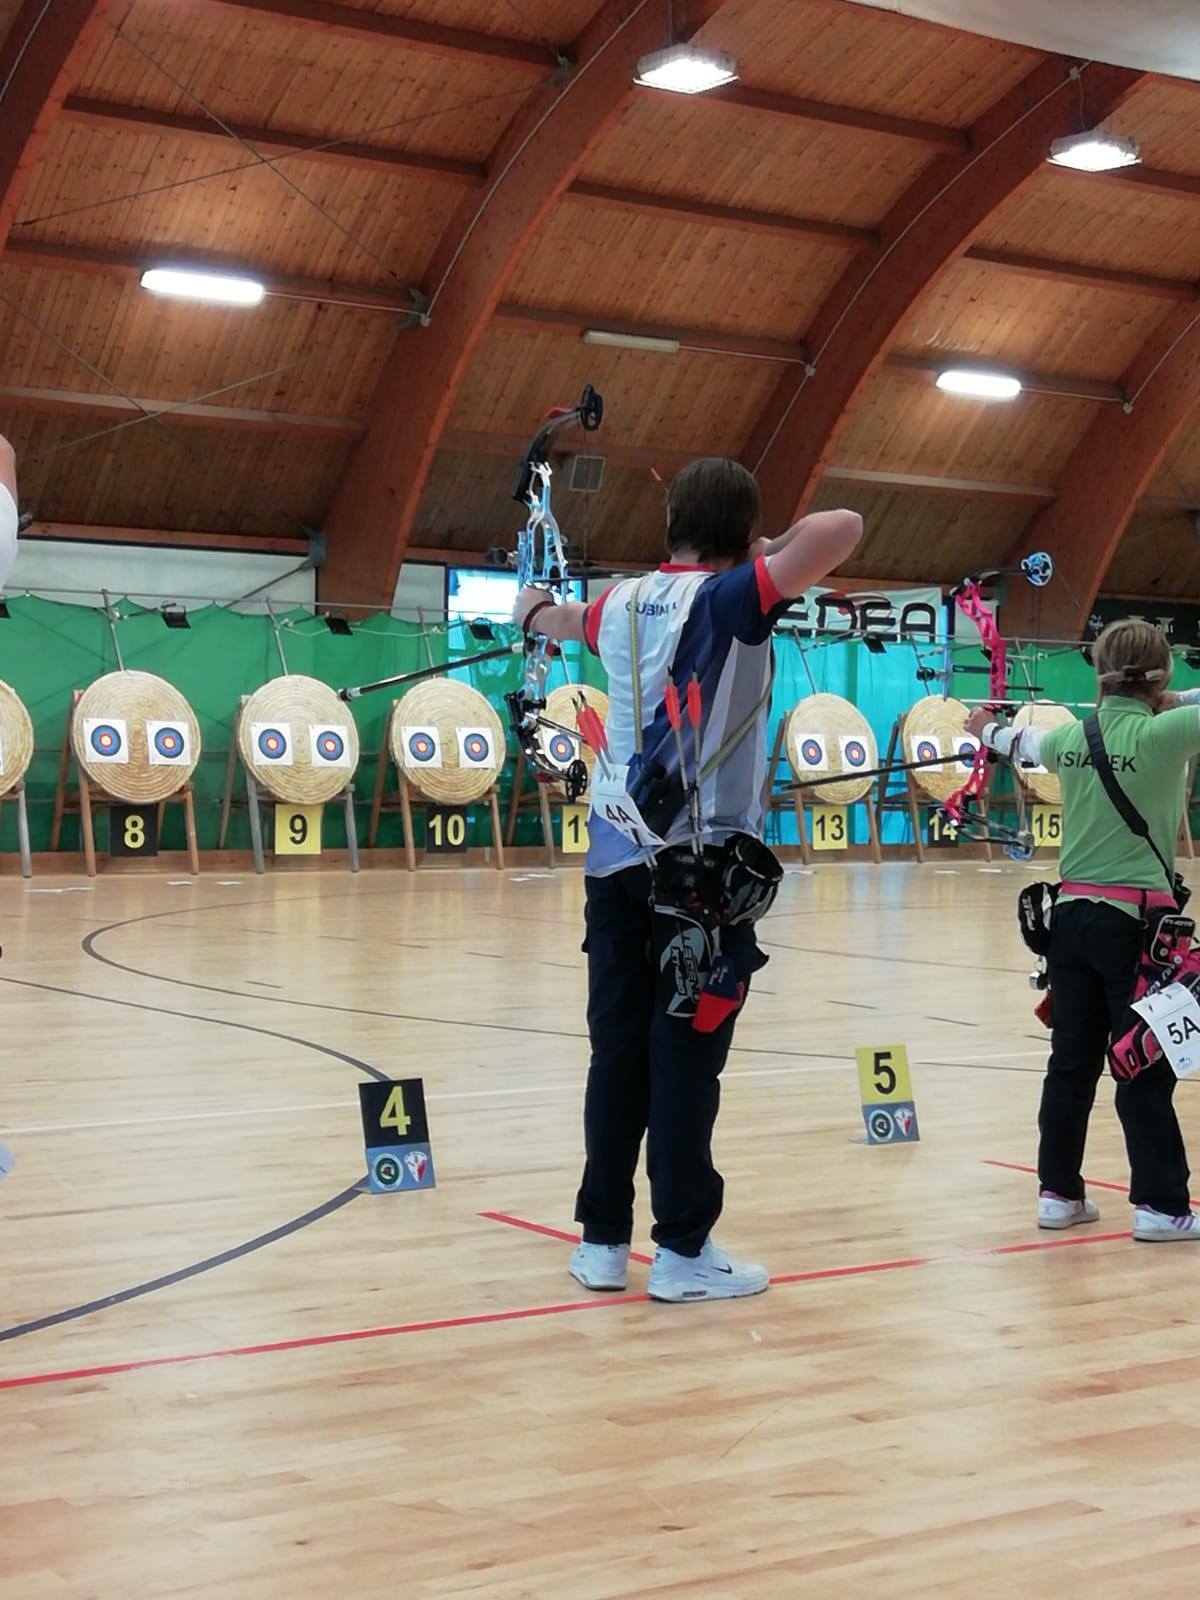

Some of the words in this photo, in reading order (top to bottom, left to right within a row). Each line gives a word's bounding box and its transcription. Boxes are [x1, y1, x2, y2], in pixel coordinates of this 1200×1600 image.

[1057, 751, 1136, 773] KSIAEK
[605, 804, 638, 825] 4A
[815, 814, 844, 842] 13
[930, 814, 958, 841] 14
[1035, 813, 1060, 839] 15
[124, 815, 145, 849] 8
[289, 814, 308, 845] 9
[428, 814, 465, 846] 10
[568, 815, 588, 844] 1
[1167, 1016, 1200, 1045] 5A
[874, 1051, 896, 1094] 5
[379, 1085, 411, 1135] 4
